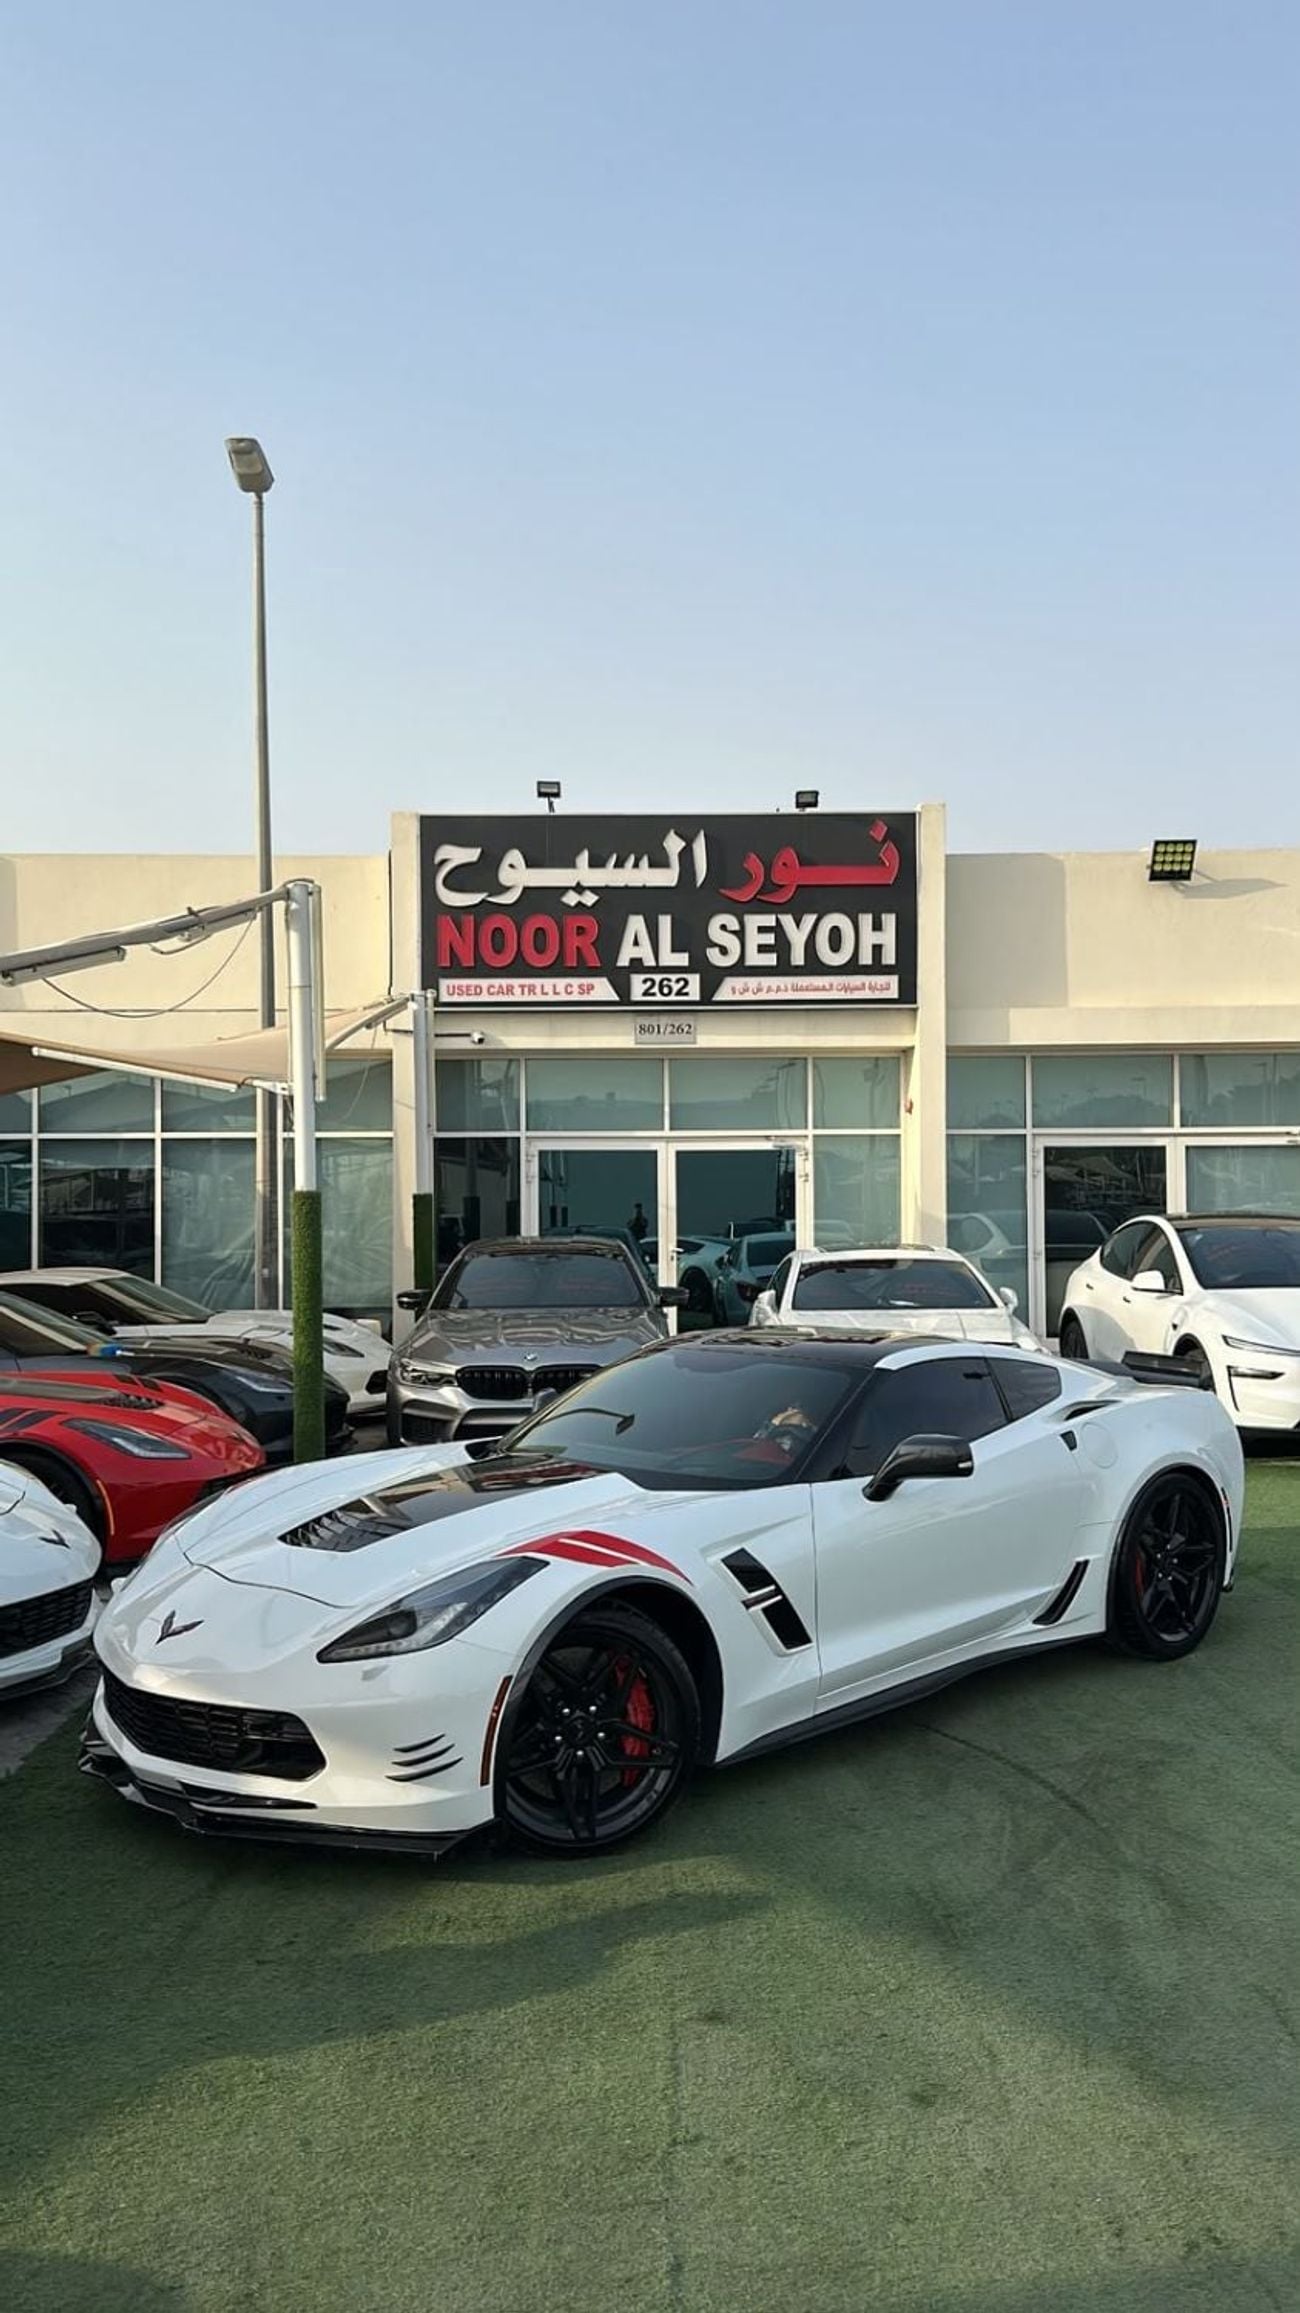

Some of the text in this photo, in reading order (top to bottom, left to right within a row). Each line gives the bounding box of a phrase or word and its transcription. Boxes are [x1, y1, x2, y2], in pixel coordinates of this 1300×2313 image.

[434, 818, 900, 907] نور السيوح
[436, 913, 897, 968] NOOR AL SEYOH
[446, 983, 596, 996] USED CAR TR L L C SP
[641, 977, 690, 997] 262
[638, 1023, 693, 1037] 801/262
